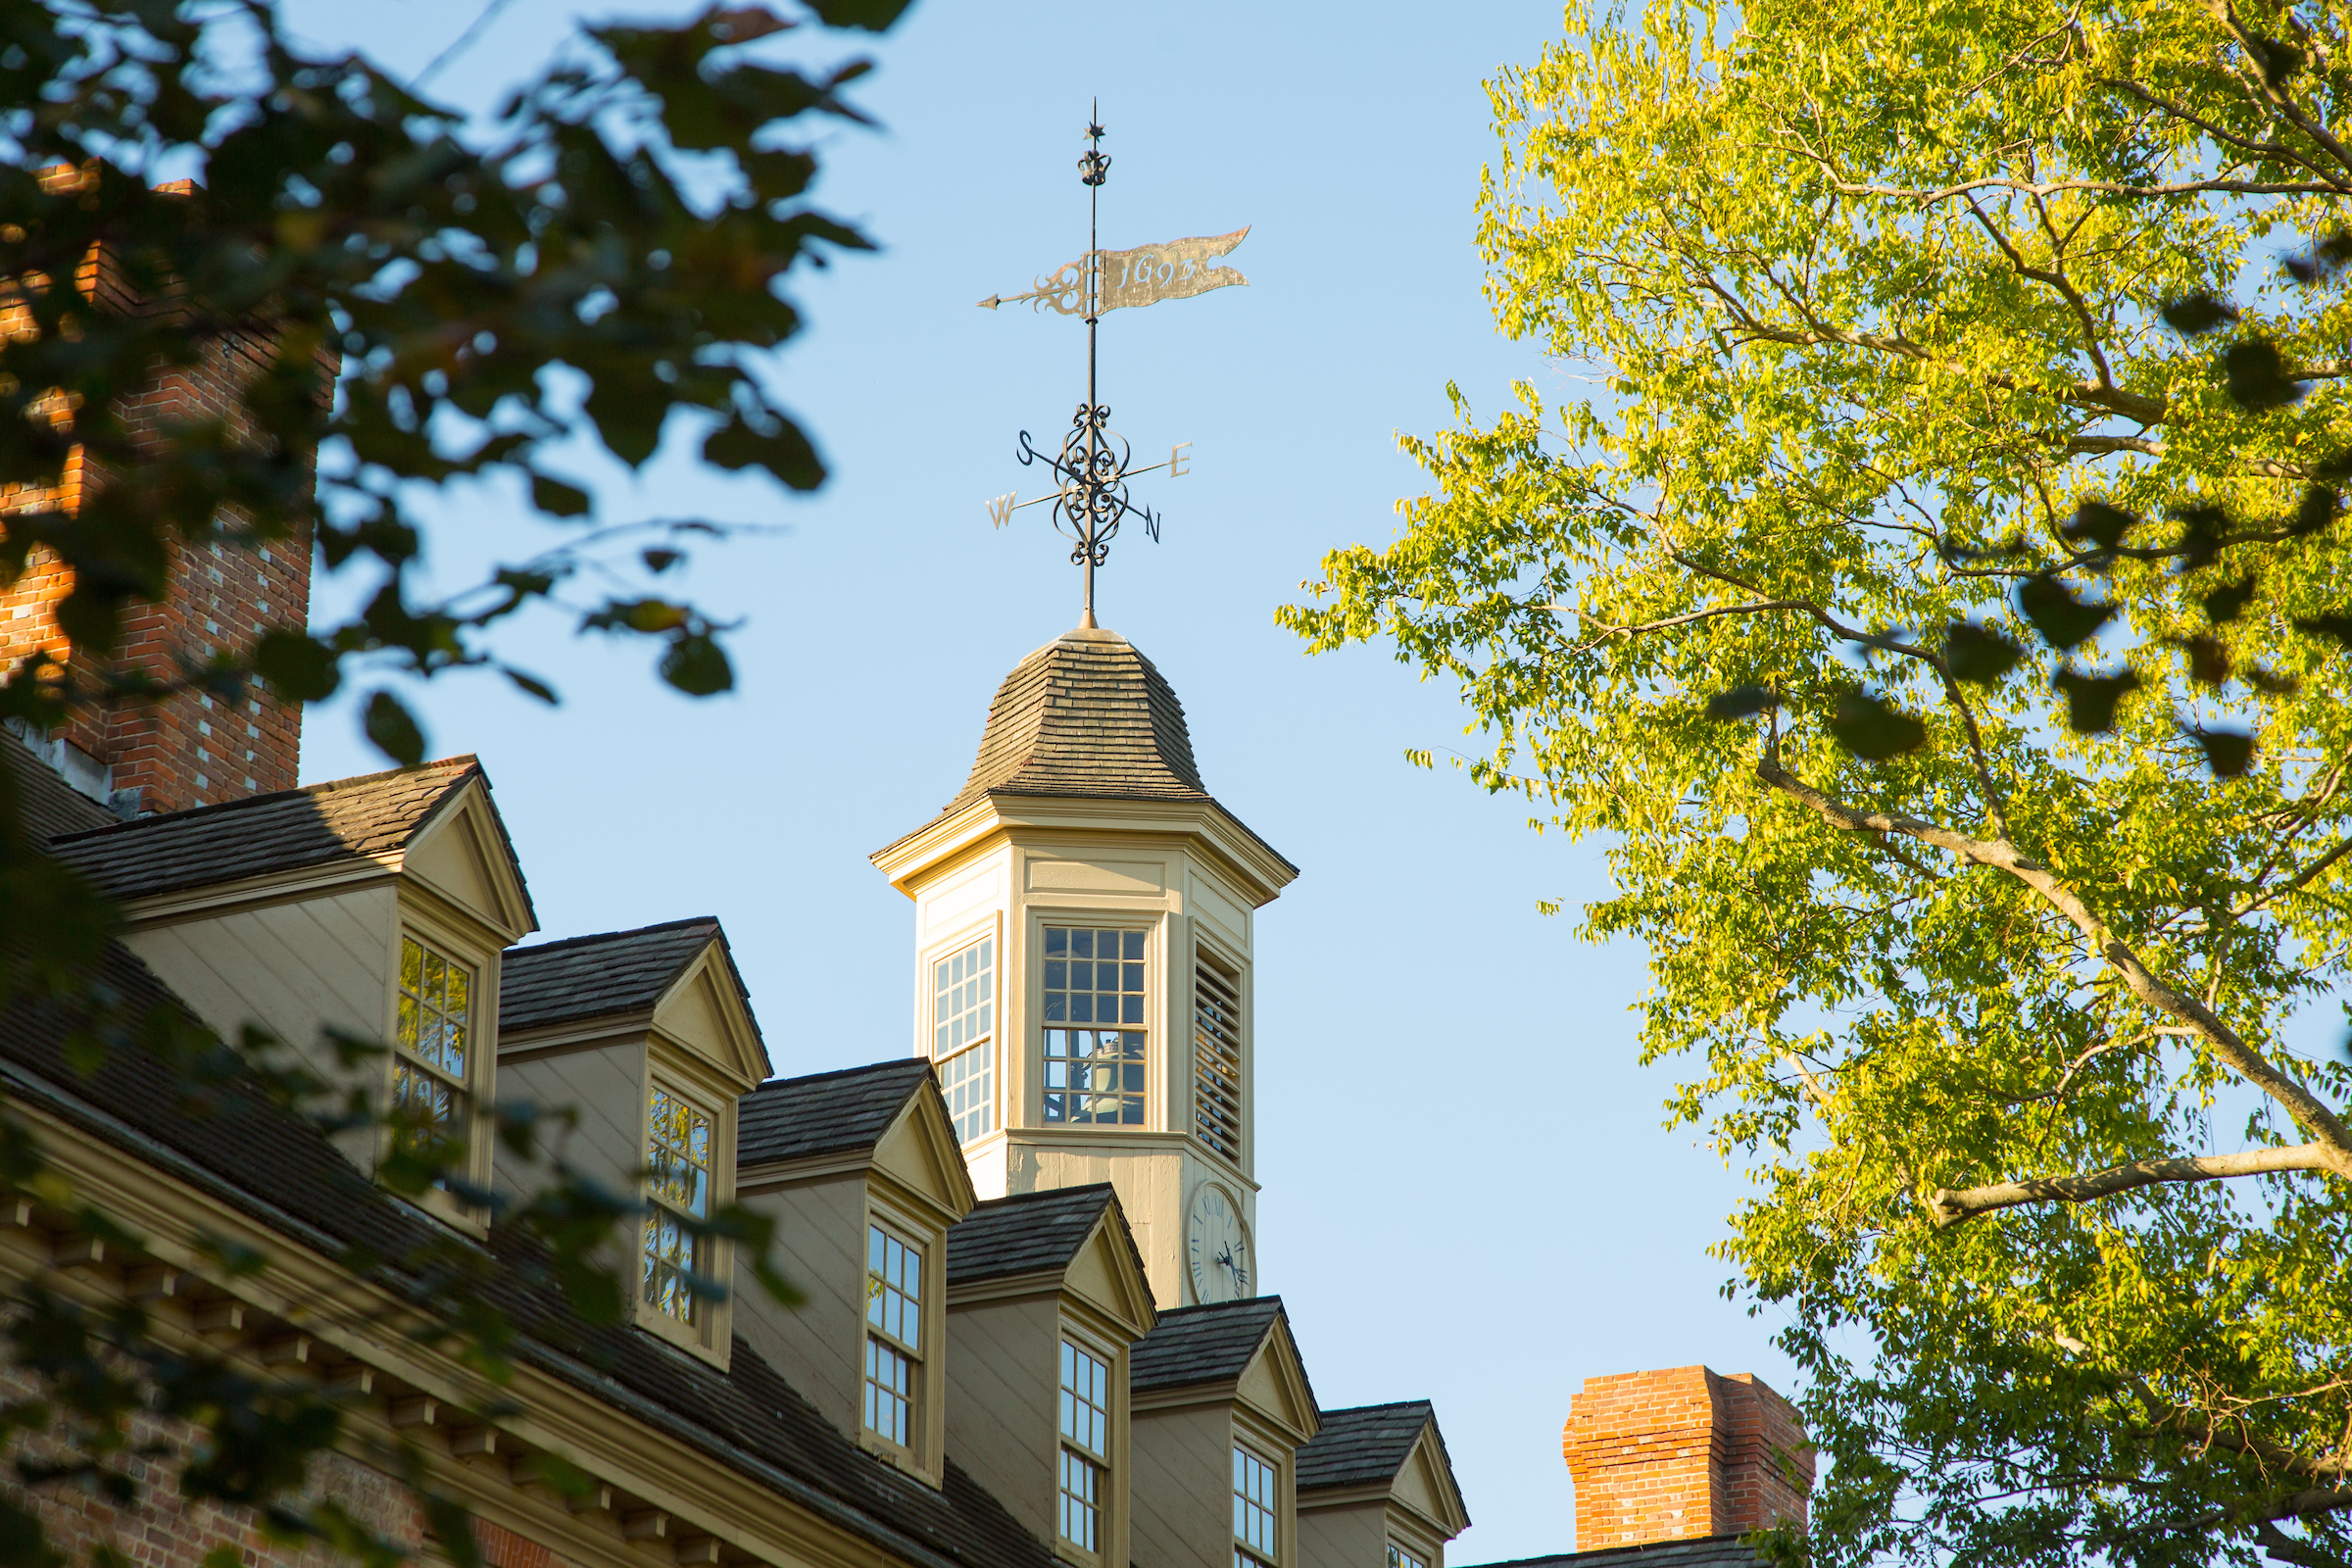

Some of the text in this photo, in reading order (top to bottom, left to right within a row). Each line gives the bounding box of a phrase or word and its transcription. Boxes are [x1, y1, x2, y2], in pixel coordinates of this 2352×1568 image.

[1116, 254, 1196, 289] 1693
[1016, 429, 1033, 466] S
[1170, 441, 1194, 478] E
[985, 491, 1018, 530] W
[1146, 503, 1161, 545] N
